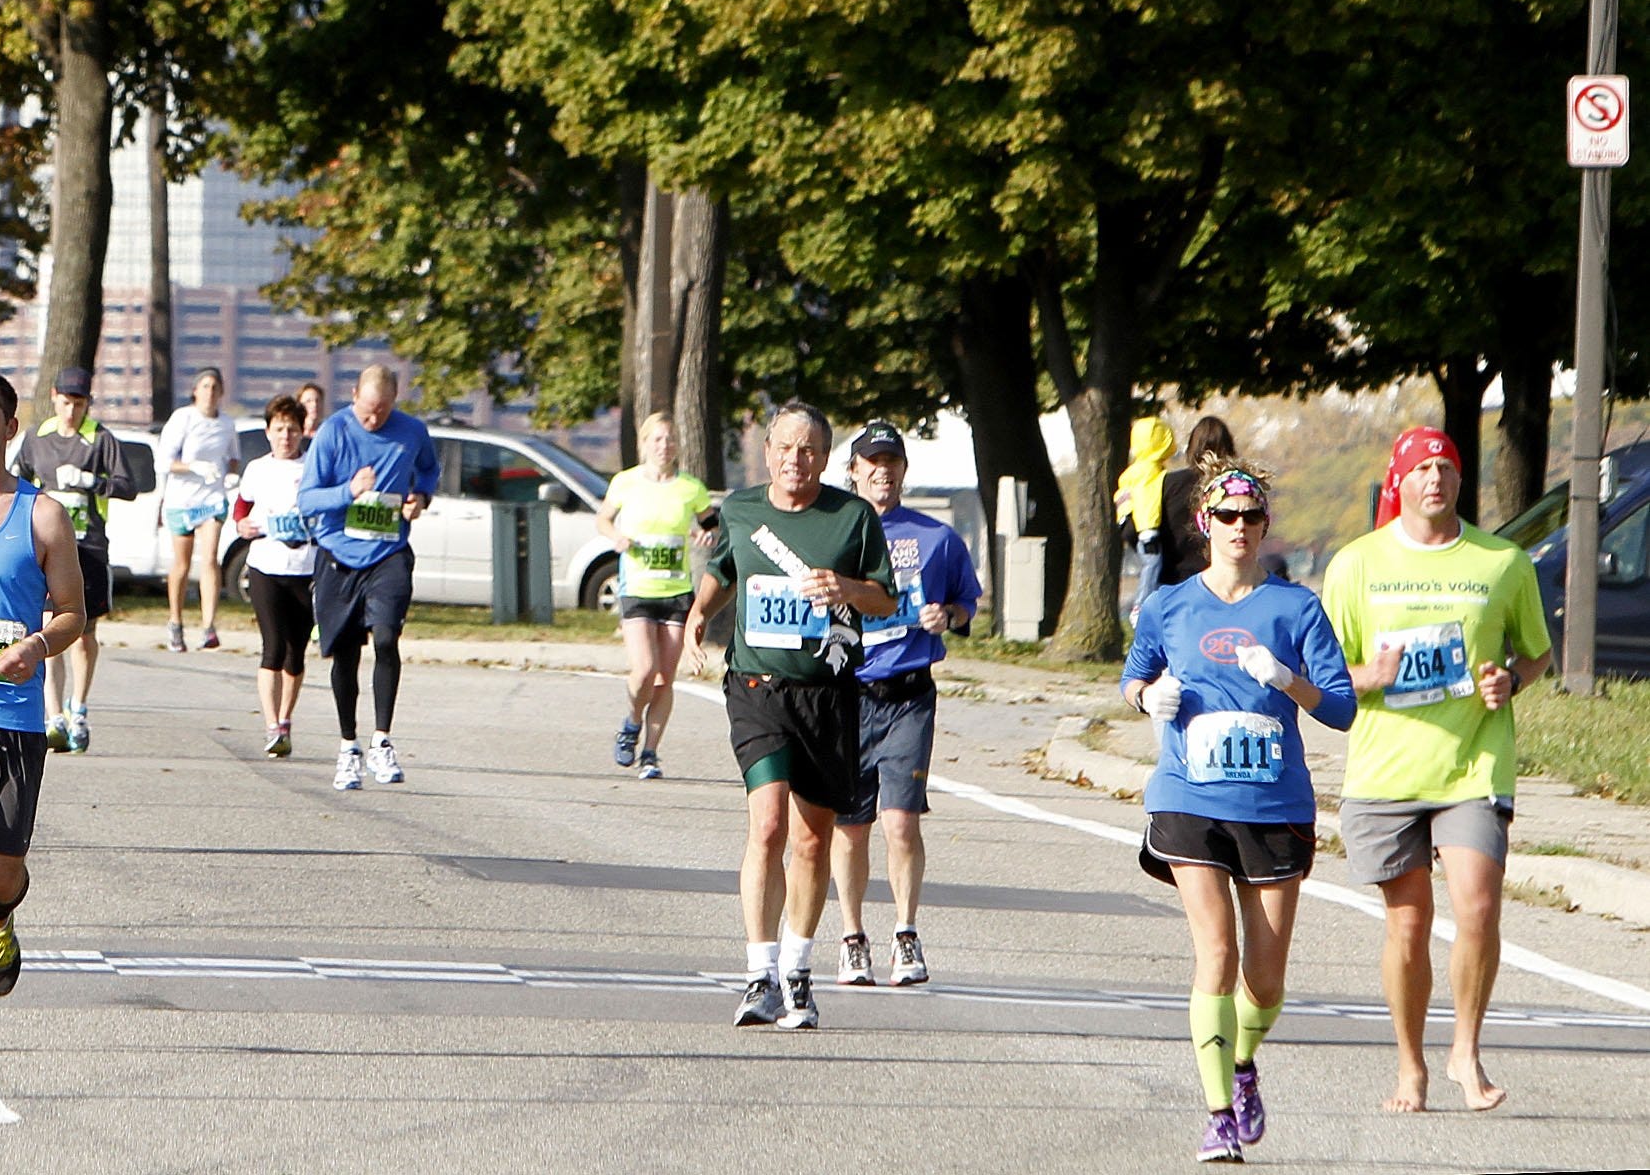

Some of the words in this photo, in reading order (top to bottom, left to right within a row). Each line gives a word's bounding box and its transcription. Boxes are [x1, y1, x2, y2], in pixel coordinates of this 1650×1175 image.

[1448, 580, 1490, 594] voice
[760, 597, 812, 626] 3317
[1401, 647, 1447, 683] 264
